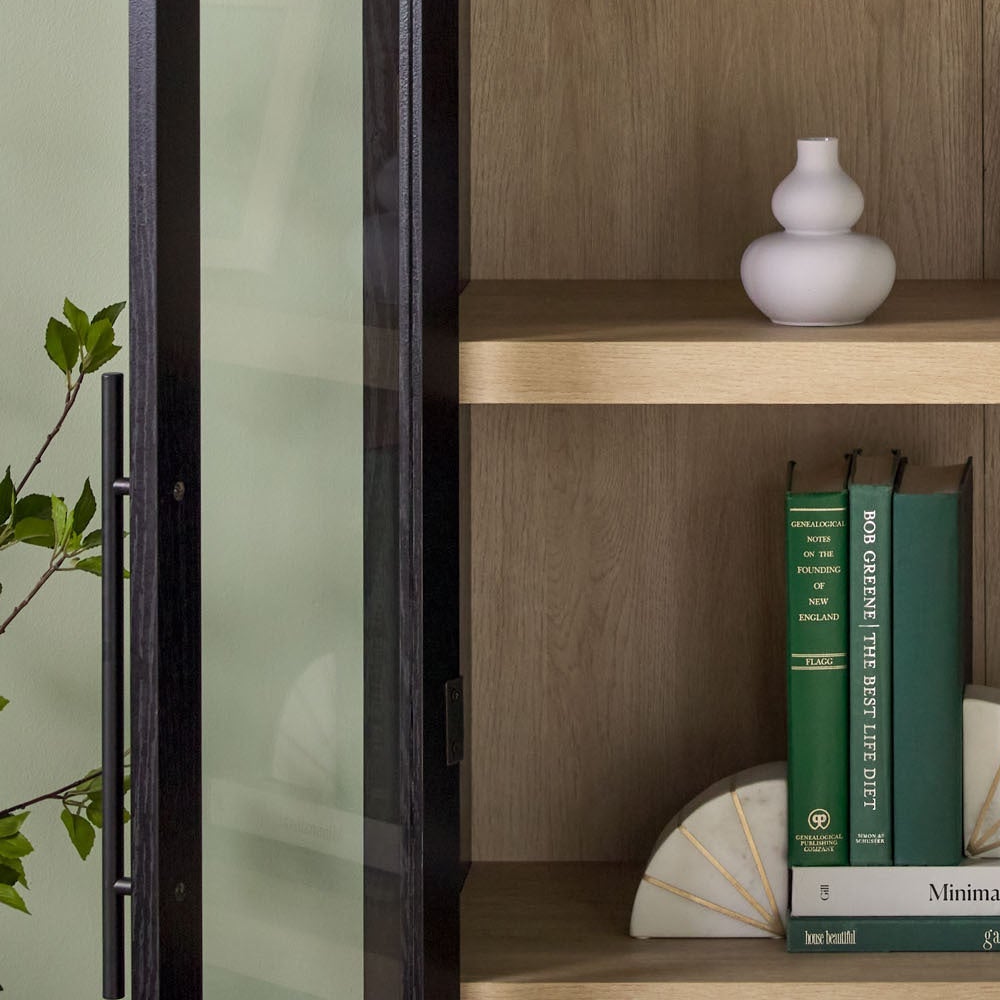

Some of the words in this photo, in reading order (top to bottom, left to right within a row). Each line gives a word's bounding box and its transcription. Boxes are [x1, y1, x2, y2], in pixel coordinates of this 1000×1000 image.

[864, 510, 876, 544] BOB
[864, 551, 876, 619] GREENE
[864, 633, 876, 668] THE
[863, 676, 876, 718] BEST
[863, 724, 876, 762] LIFE
[863, 769, 876, 811] DIET
[820, 884, 830, 901] Gill
[805, 930, 824, 945] house
[826, 930, 856, 945] beautiful
